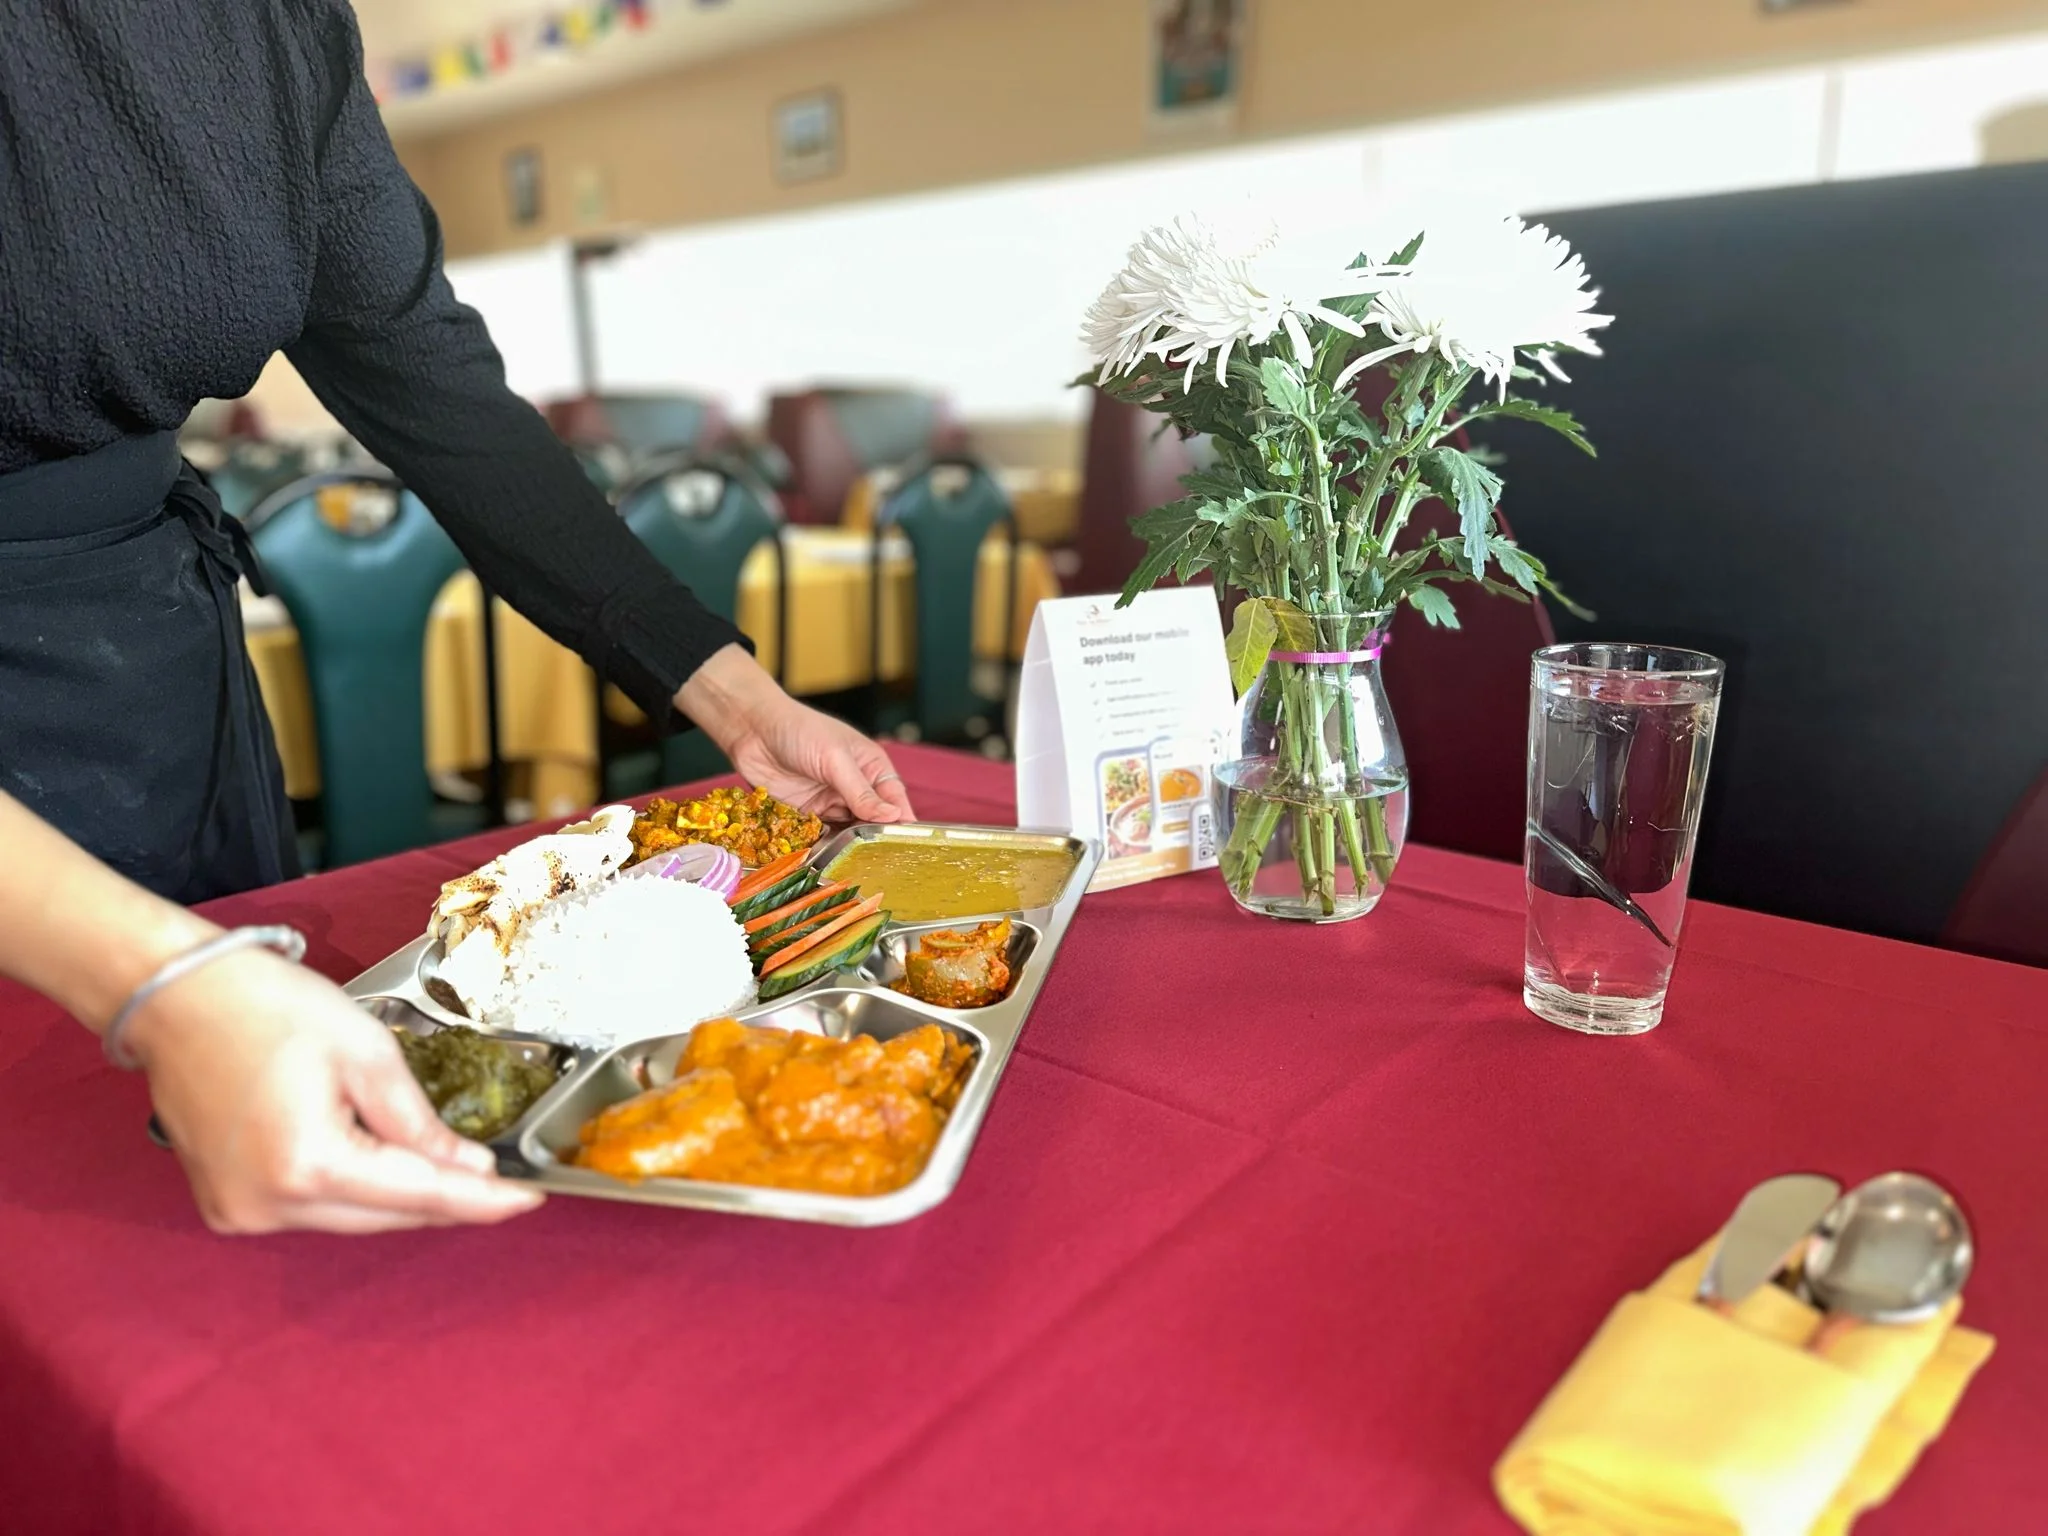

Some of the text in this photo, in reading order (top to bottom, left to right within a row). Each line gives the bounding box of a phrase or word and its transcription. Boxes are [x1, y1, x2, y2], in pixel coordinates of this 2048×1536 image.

[1079, 632, 1134, 648] Download
[1135, 632, 1152, 642] our
[1083, 650, 1136, 667] app today
